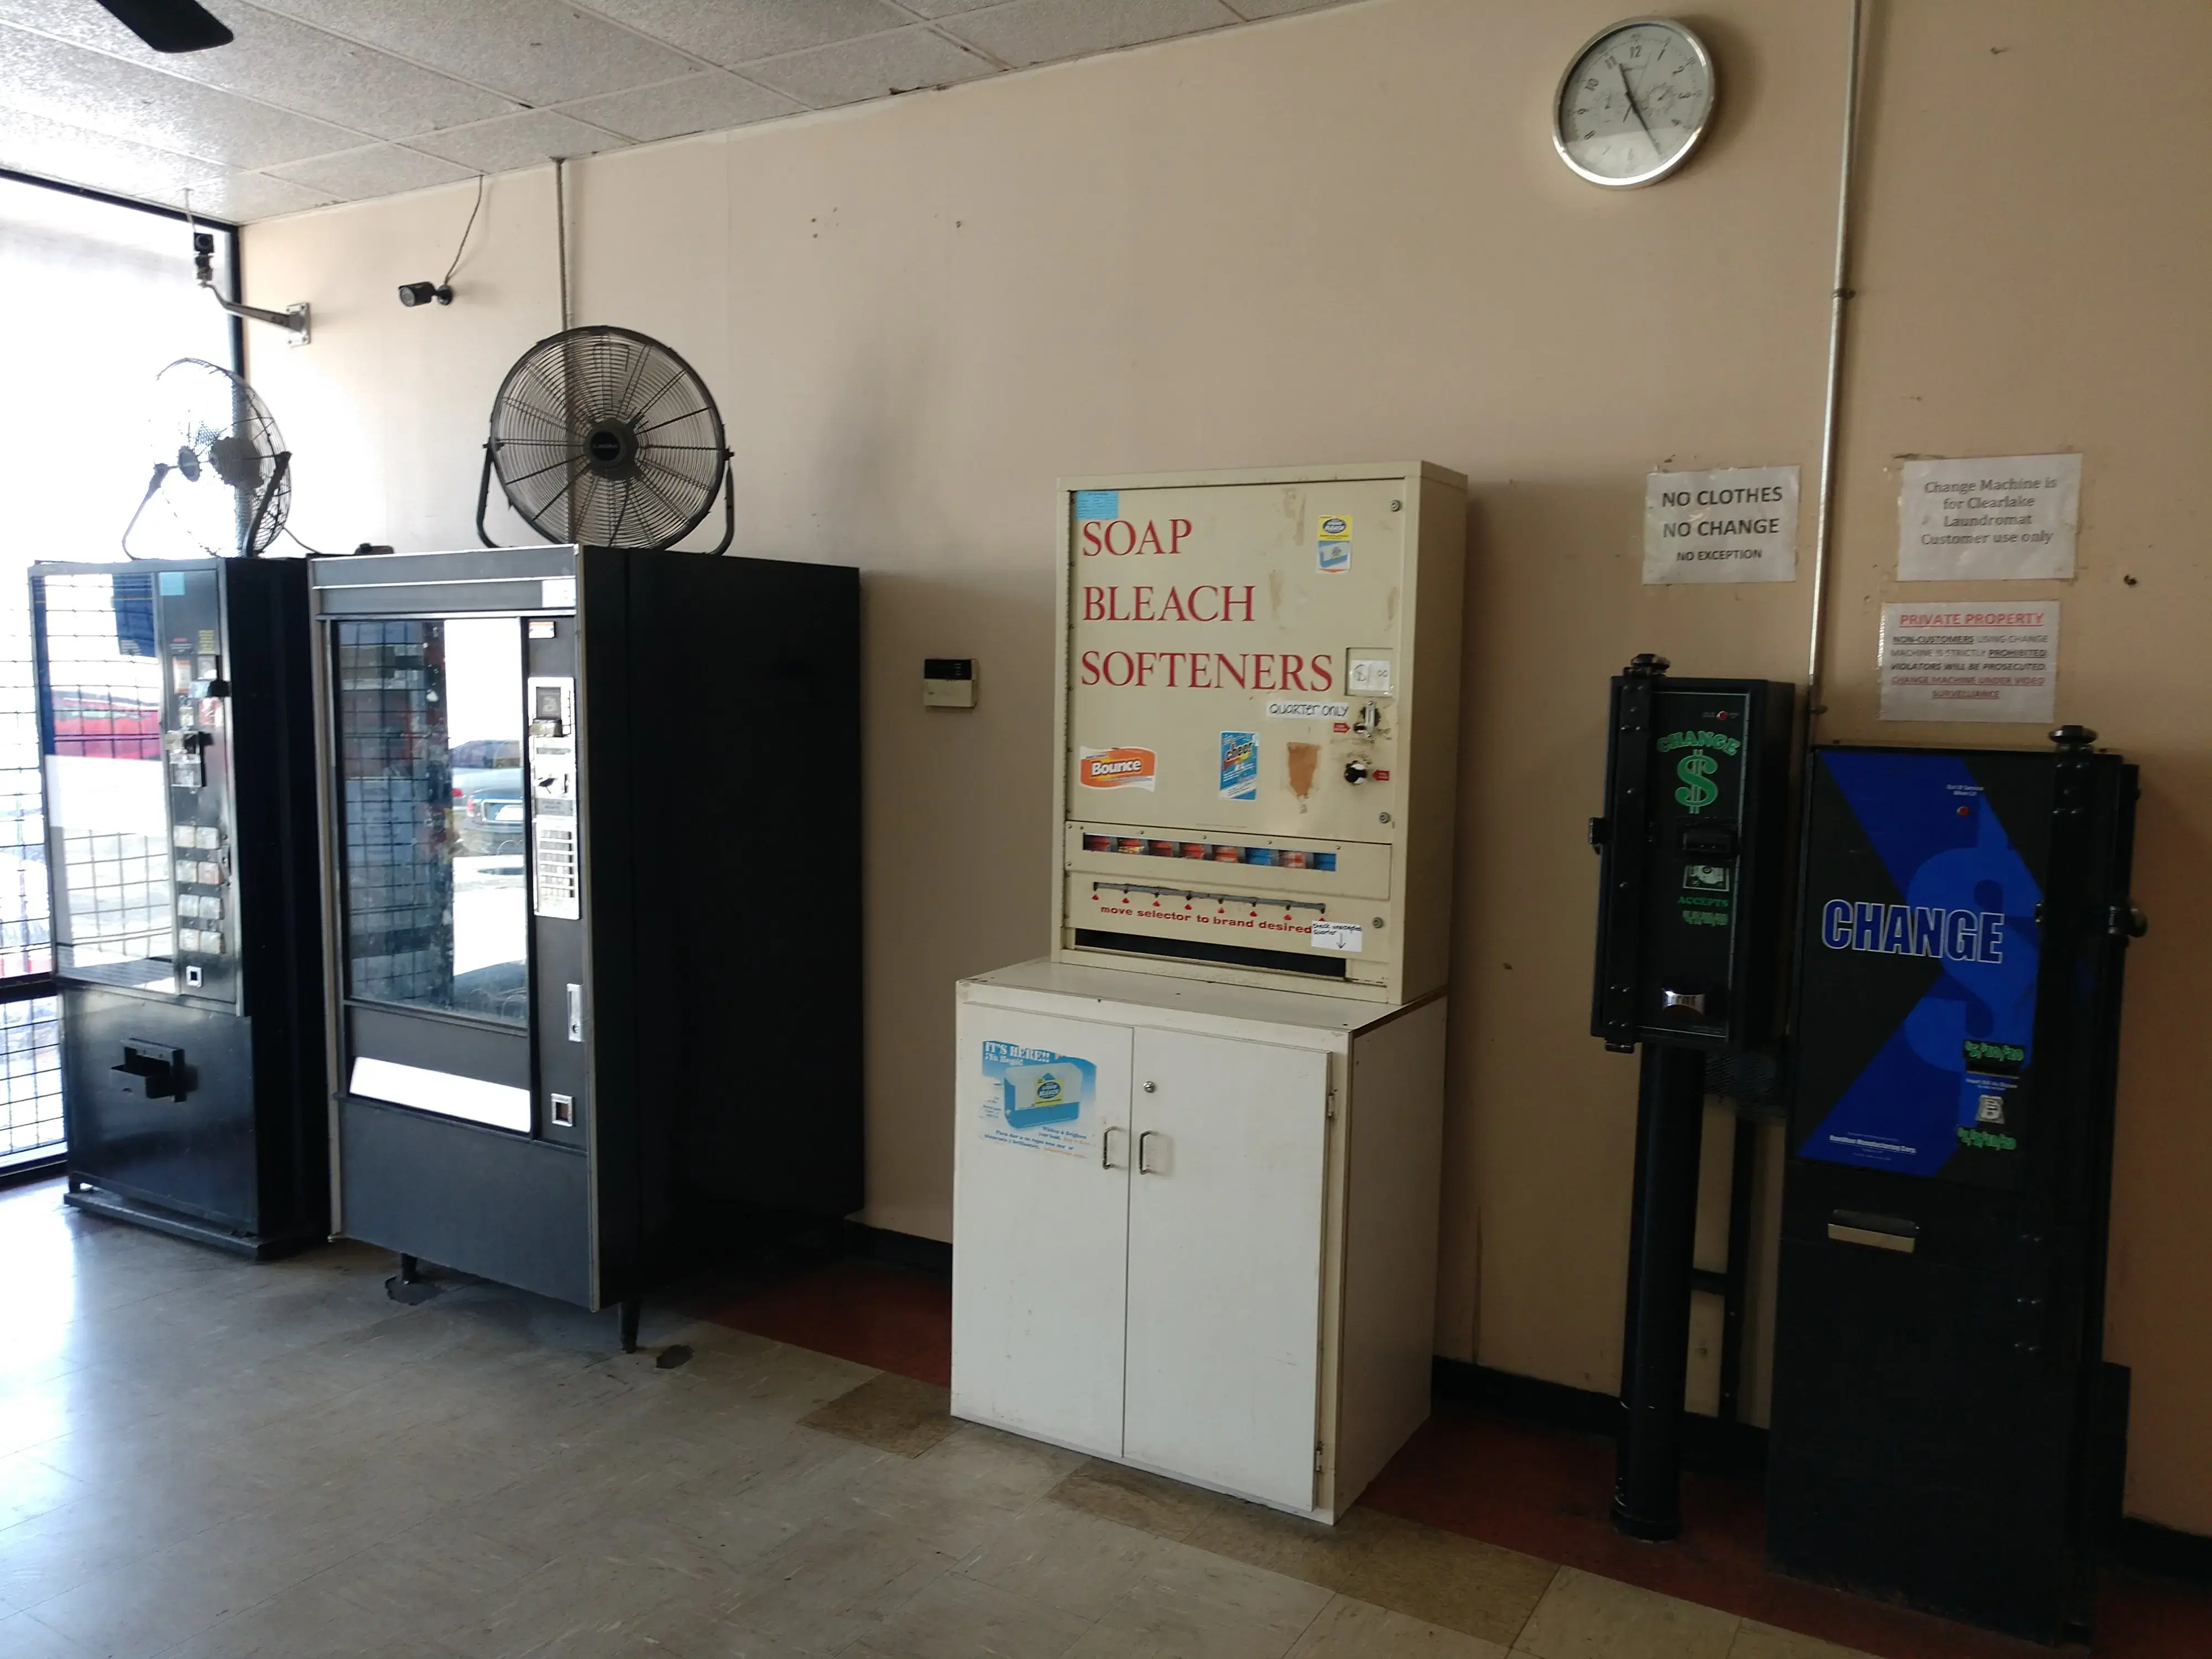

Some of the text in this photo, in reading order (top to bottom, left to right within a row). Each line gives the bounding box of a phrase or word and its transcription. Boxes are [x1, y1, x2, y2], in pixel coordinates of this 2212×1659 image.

[1629, 45, 1642, 59] 12
[1584, 77, 1600, 92] 10
[1924, 477, 2058, 495] Change Machine is
[1661, 486, 1783, 508] NO CLOTHES
[1942, 495, 2036, 510] for Clearlake
[1662, 518, 1780, 539] NO CHANGE
[1942, 514, 2033, 528] Laundromat
[1082, 518, 1192, 557] SOAP
[1921, 530, 2054, 546] Customer use only
[1676, 549, 1763, 562] NO EXCEPTION
[1083, 585, 1256, 622] BLEACH
[1900, 612, 2045, 625] PRIVATE PROPERTY
[1081, 650, 1333, 692] SOFTENERS
[1656, 731, 1741, 756] CHANGE
[1091, 760, 1142, 776] Bounce
[1677, 895, 1730, 907] ACCEPTS
[1100, 906, 1133, 916] move
[1136, 910, 1192, 921] selector
[1196, 914, 1210, 924] to
[1213, 916, 1254, 928] brand
[1258, 920, 1312, 933] desired
[1822, 899, 2006, 964] CHANGE
